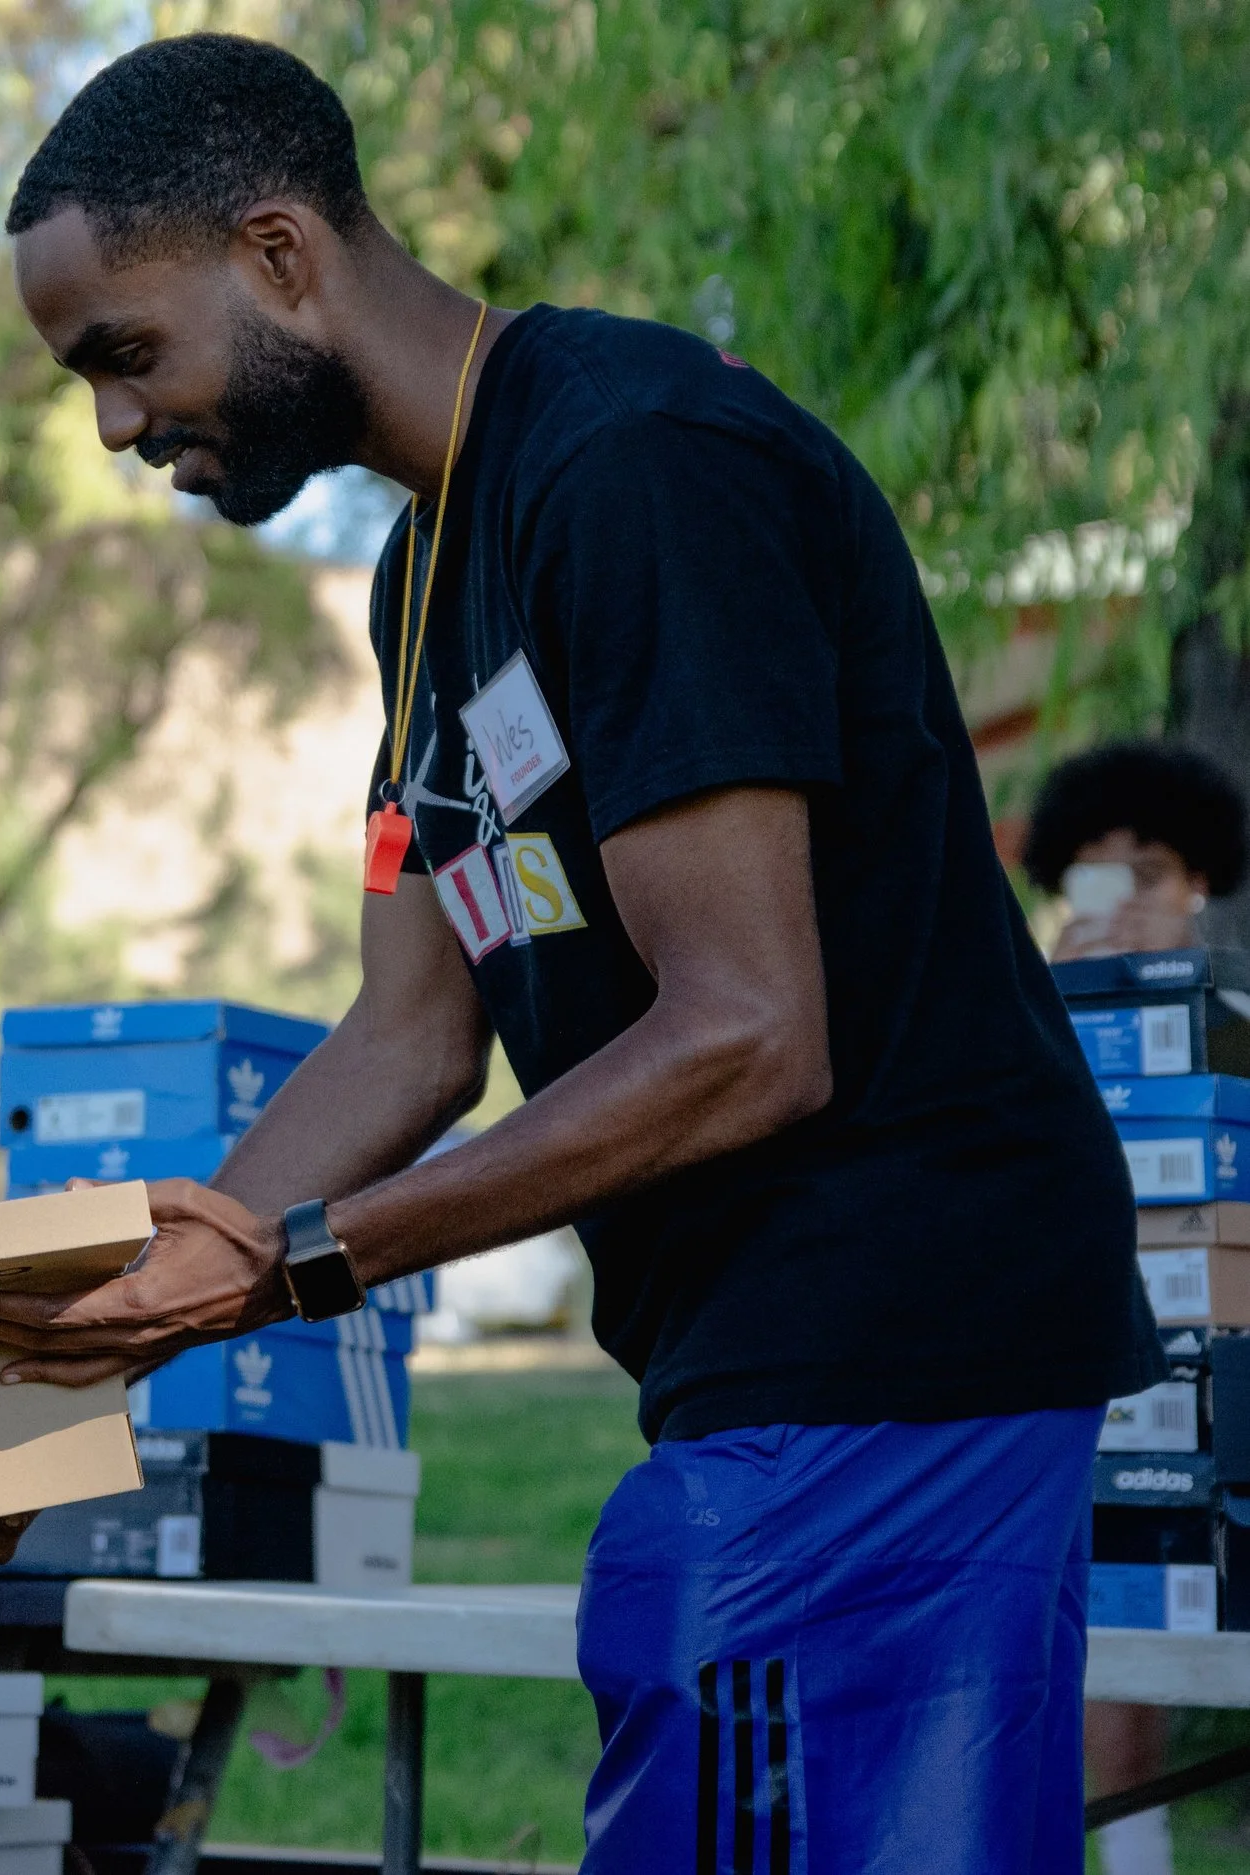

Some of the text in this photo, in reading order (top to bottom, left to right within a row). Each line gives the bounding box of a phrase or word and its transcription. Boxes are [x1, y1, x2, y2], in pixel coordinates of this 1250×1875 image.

[481, 709, 534, 767] Wes
[510, 752, 543, 787] FOUNDER
[448, 845, 566, 945] IDS
[1113, 1467, 1194, 1493] adidas
